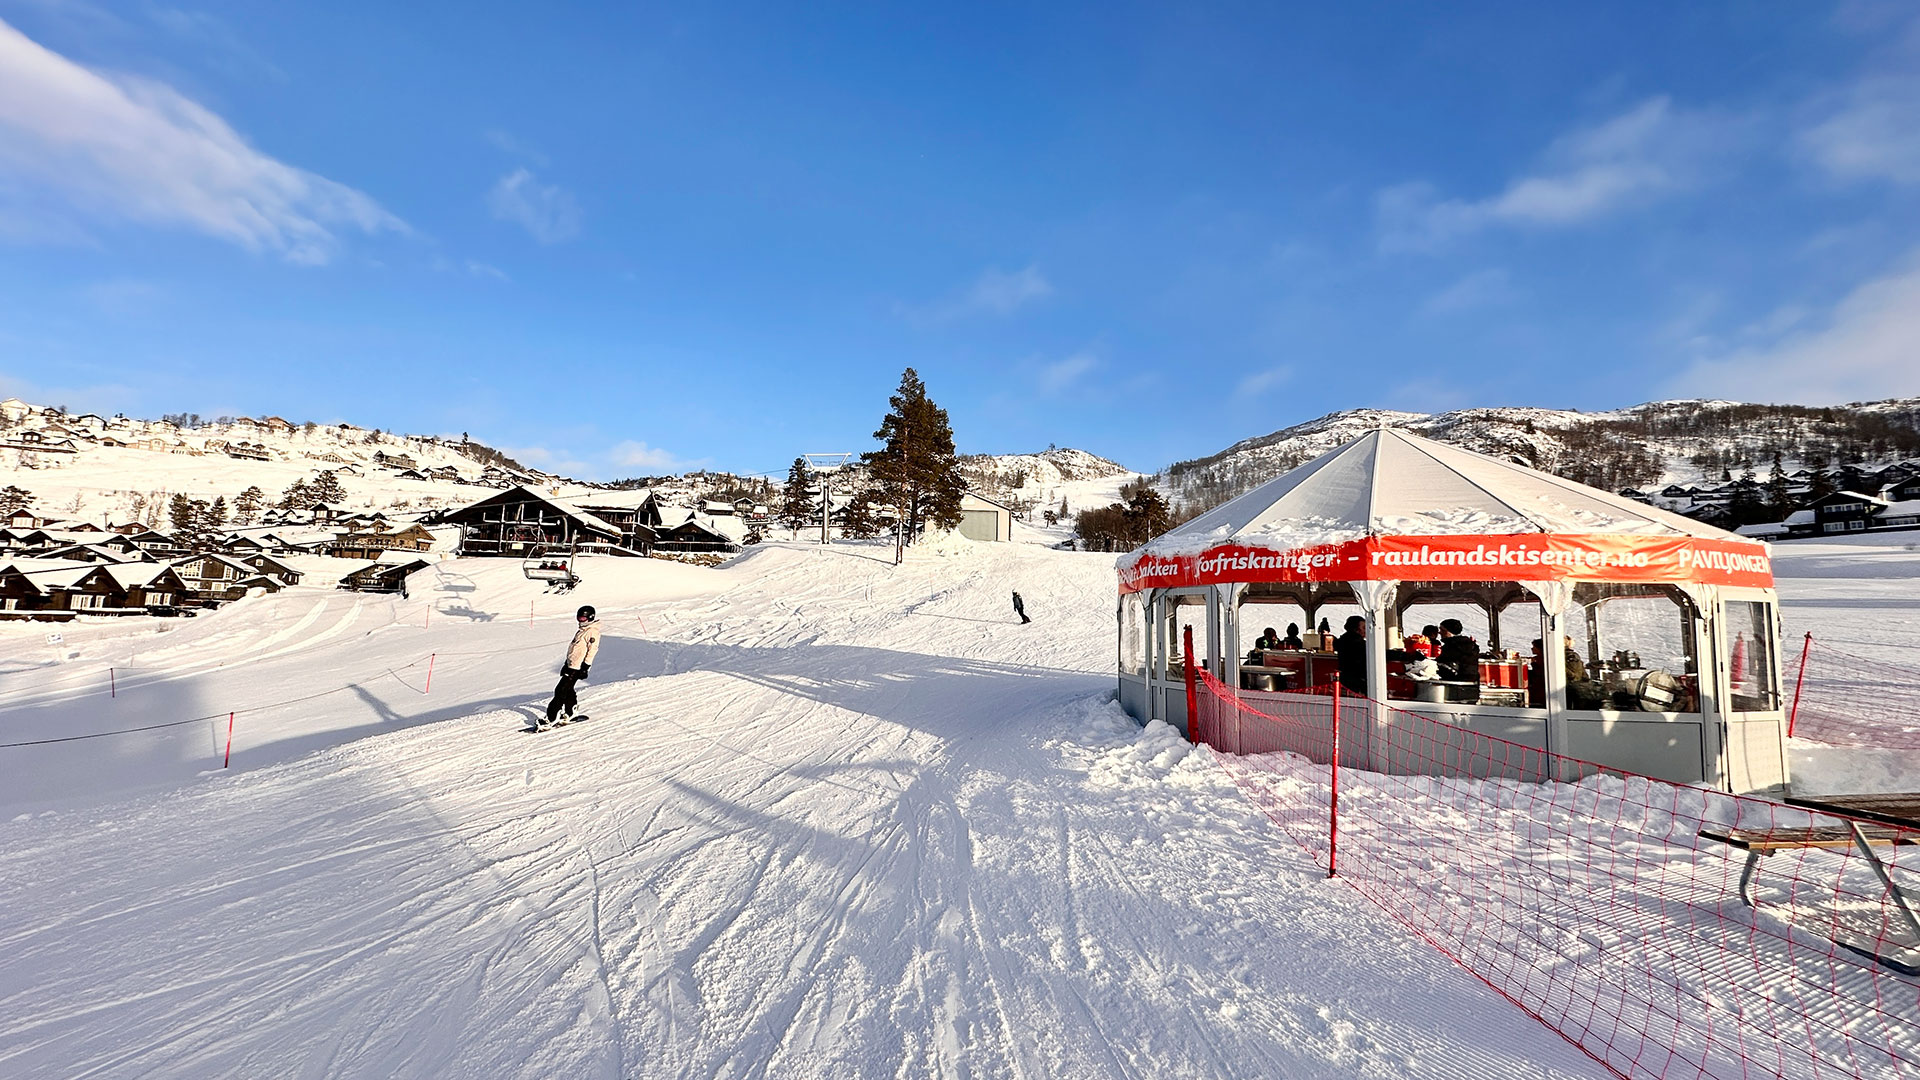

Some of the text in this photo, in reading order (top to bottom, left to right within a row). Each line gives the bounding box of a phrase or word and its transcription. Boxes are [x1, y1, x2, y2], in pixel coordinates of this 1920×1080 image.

[1194, 552, 1337, 577] forfriskninger
[1371, 544, 1649, 568] raulandskisenter.no
[1677, 548, 1770, 575] PAVILJONGEN
